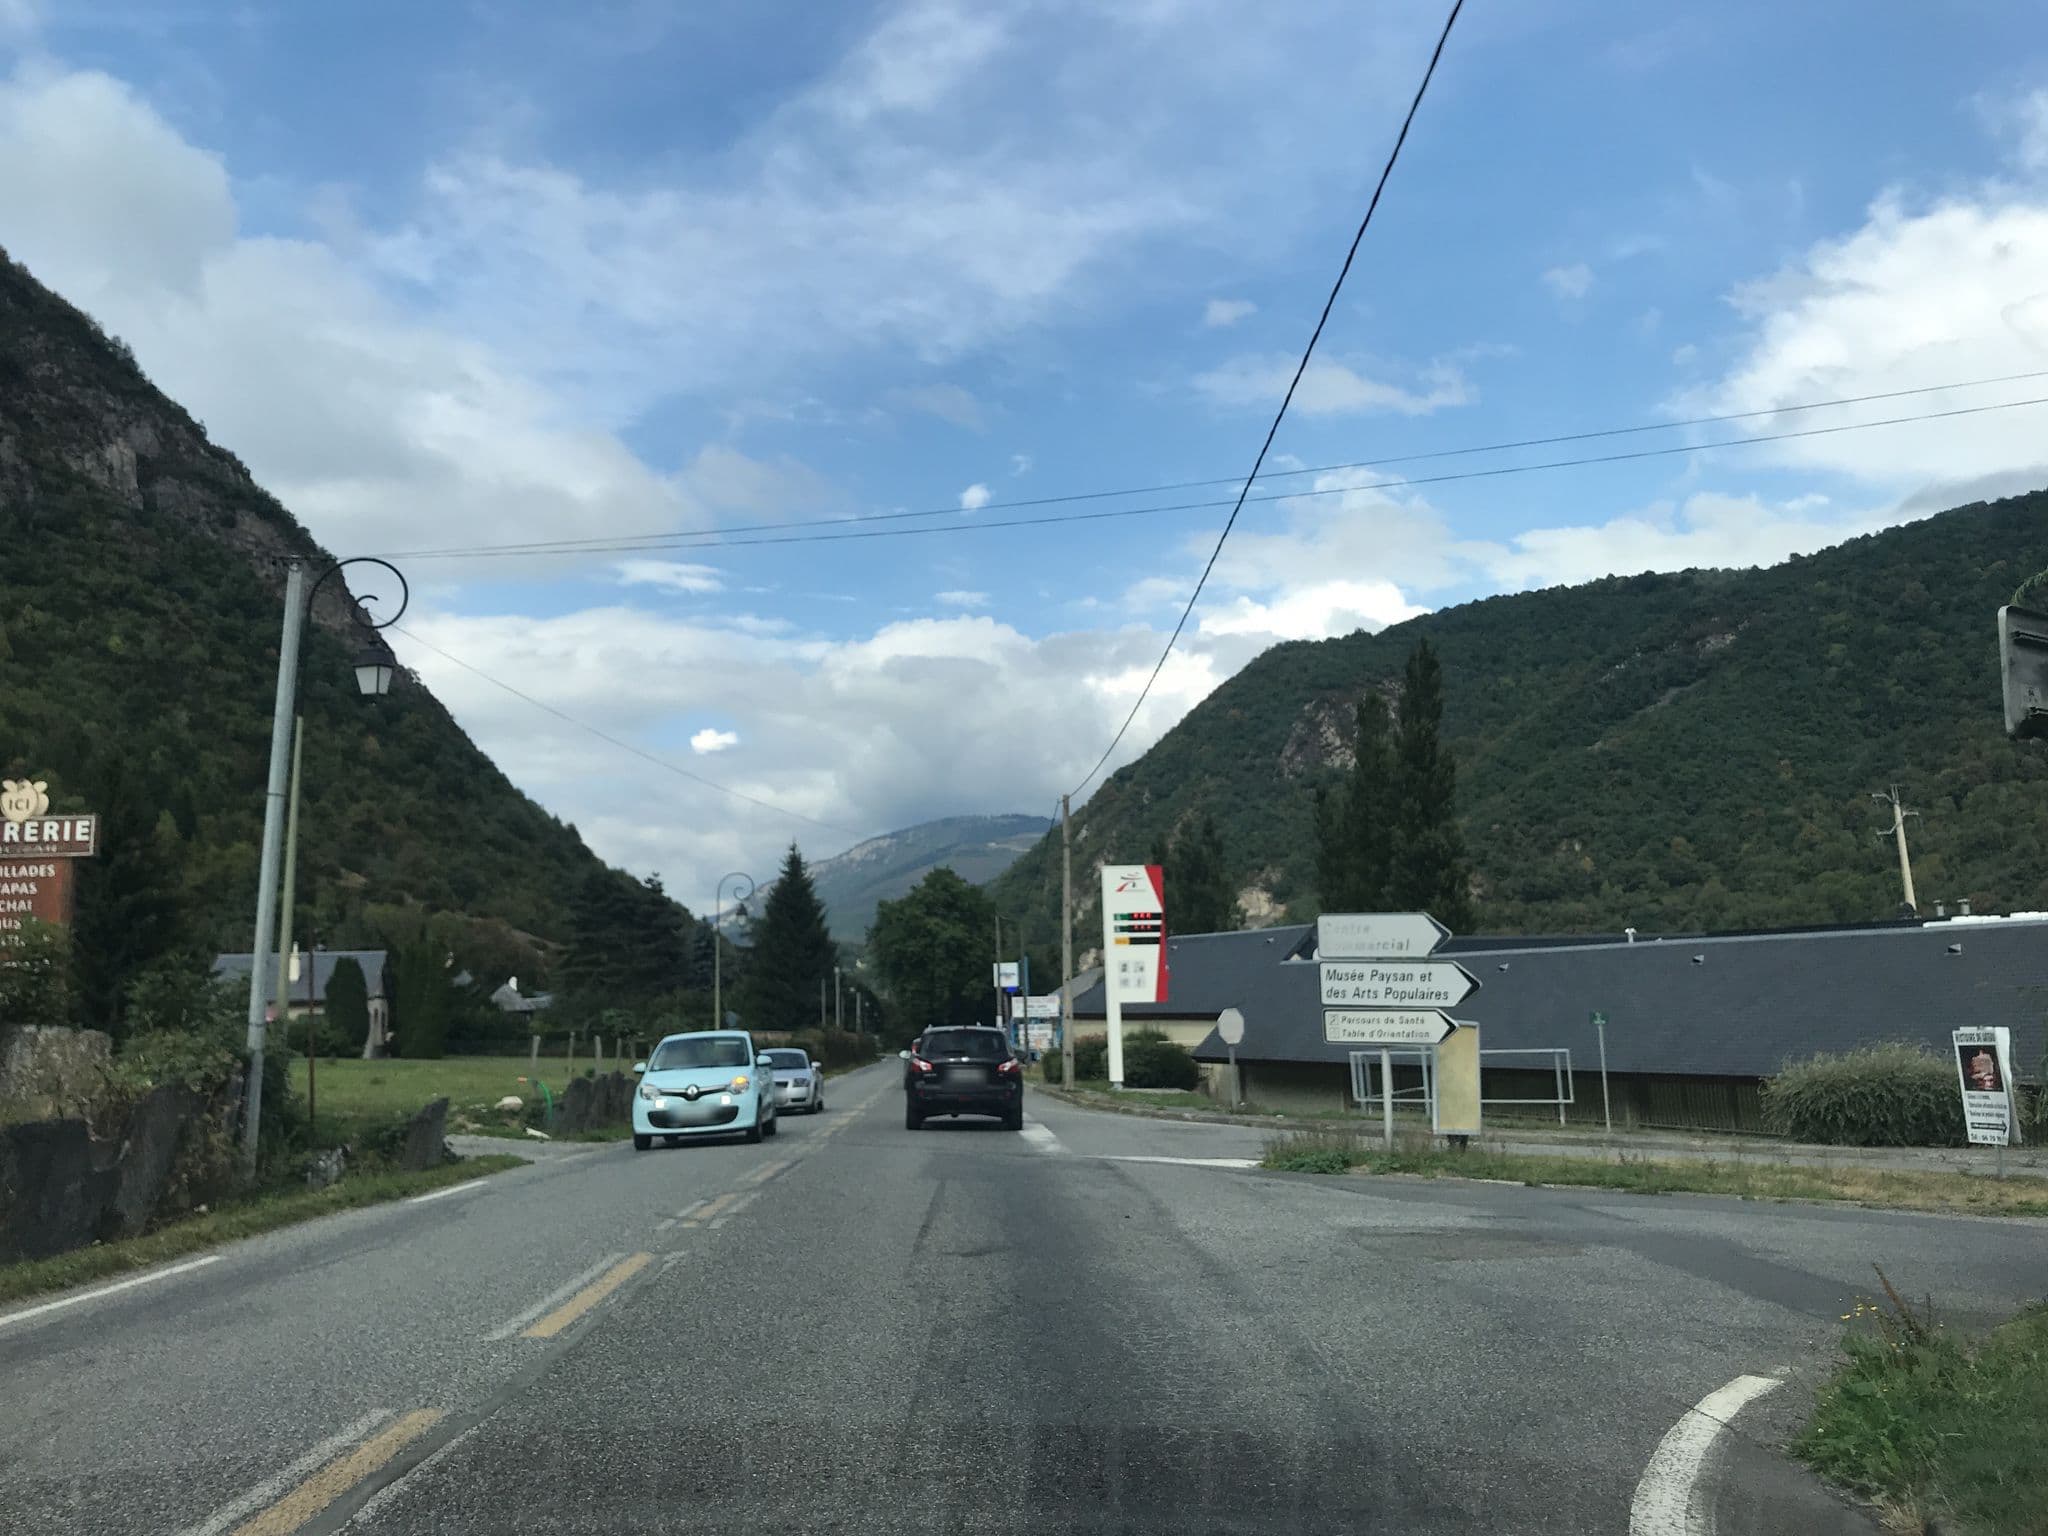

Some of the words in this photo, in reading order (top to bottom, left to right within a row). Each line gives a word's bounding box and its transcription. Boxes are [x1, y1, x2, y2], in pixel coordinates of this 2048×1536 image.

[8, 798, 30, 811] ICI
[3, 820, 91, 843] RERIE
[0, 881, 38, 896] APAS
[1325, 968, 1365, 983] Musée
[1370, 969, 1414, 986] Paysan
[1419, 971, 1433, 983] et
[1326, 986, 1347, 1000] des
[1352, 987, 1379, 1000] Arts
[1383, 987, 1449, 1003] Populaires
[1341, 1015, 1381, 1025] Parcours
[1383, 1015, 1395, 1025] de
[1398, 1015, 1426, 1025] Santé
[1342, 1029, 1365, 1038] Table
[1368, 1028, 1431, 1039] d'Orientation
